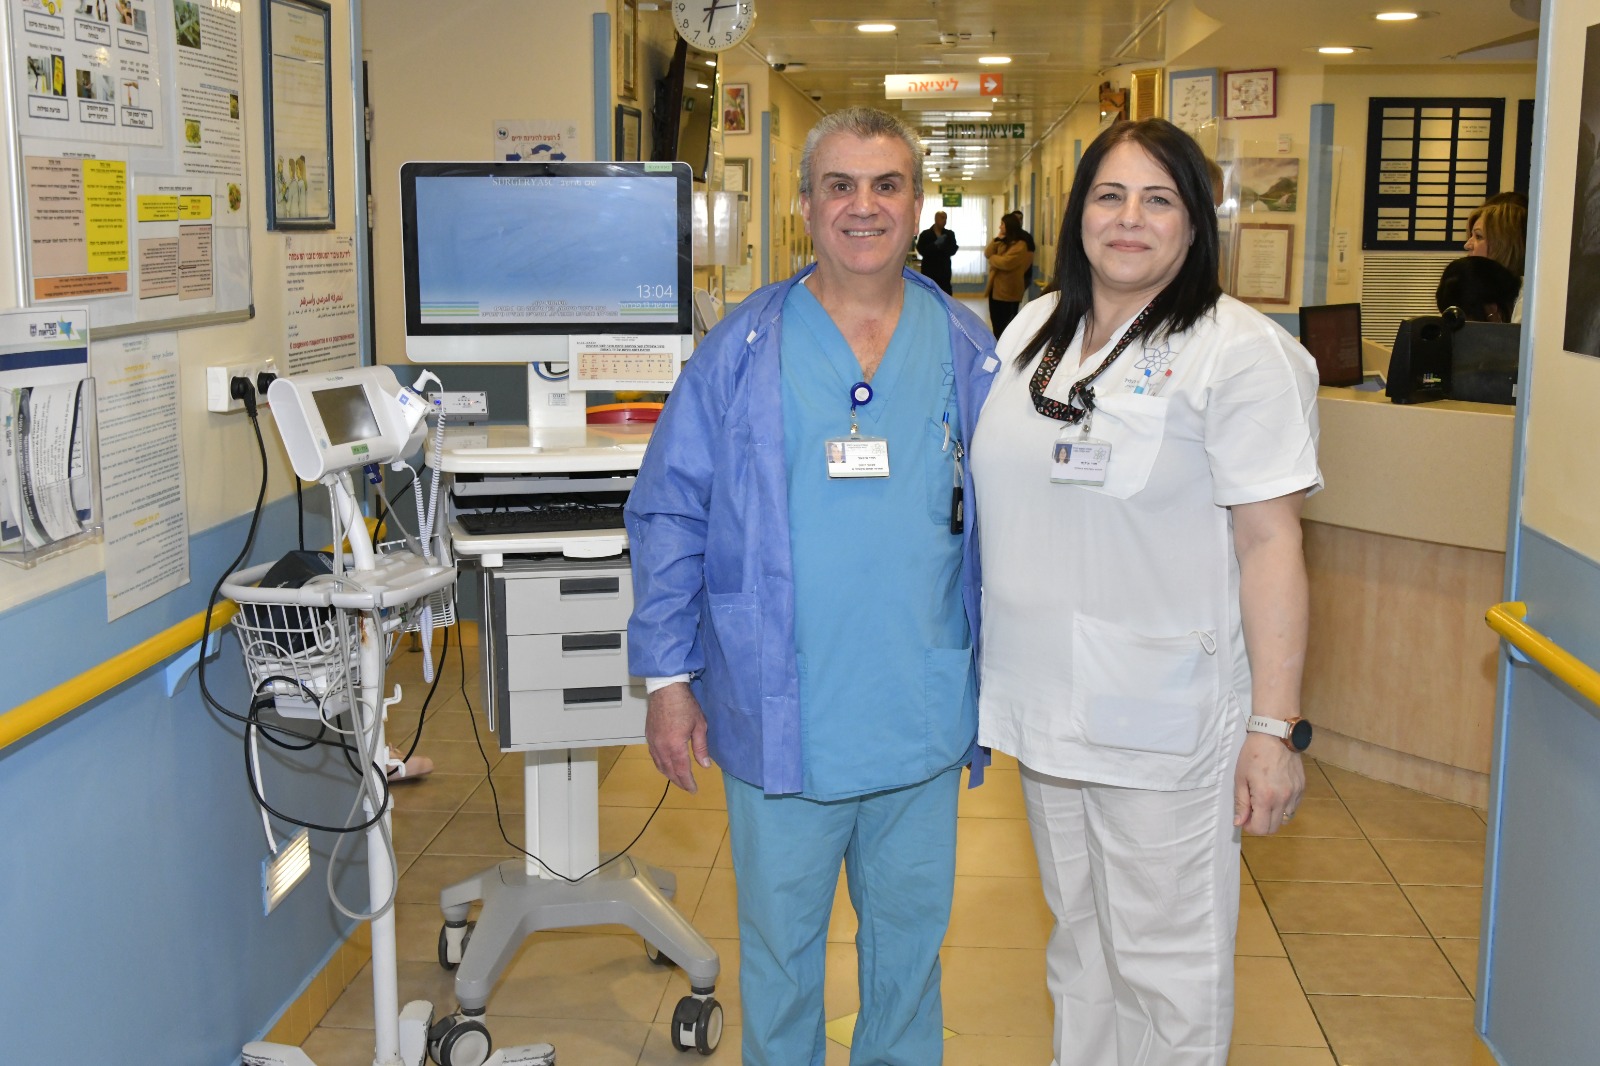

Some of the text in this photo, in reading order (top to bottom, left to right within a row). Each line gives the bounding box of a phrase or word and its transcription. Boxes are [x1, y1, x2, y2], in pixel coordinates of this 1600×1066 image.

[679, 3, 685, 12] 9
[683, 19, 689, 28] 8
[736, 22, 742, 30] 4
[694, 31, 700, 40] 7
[726, 32, 732, 41] 5
[708, 36, 715, 45] 6
[908, 77, 959, 92] ליציאה
[946, 124, 1012, 138] יציאת חירום
[636, 284, 672, 298] 13:04
